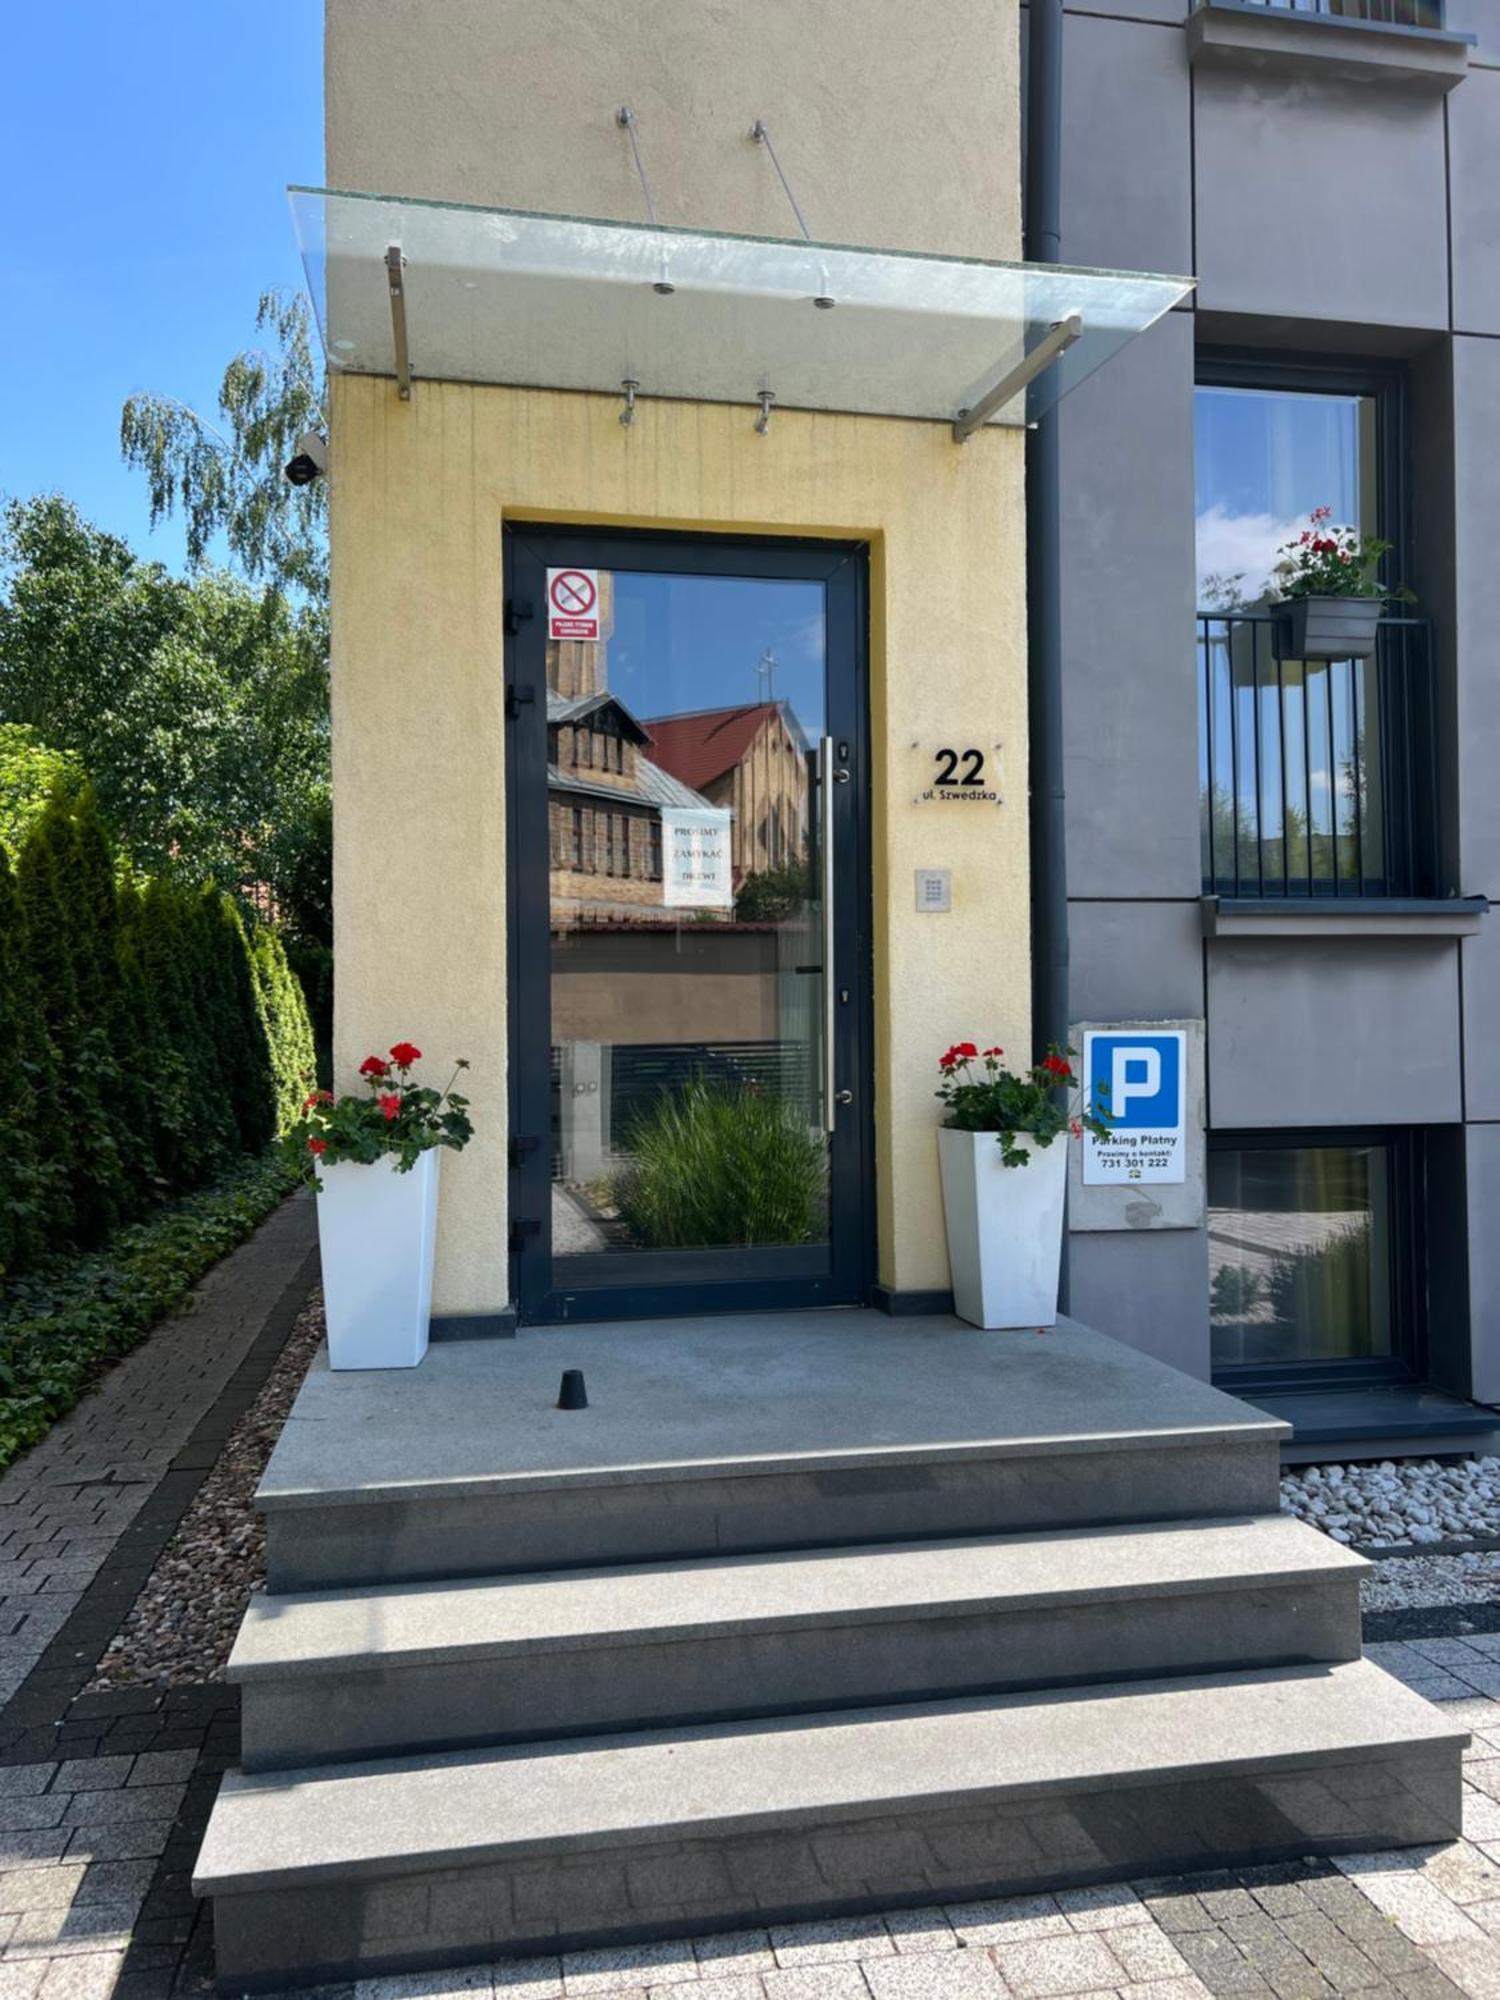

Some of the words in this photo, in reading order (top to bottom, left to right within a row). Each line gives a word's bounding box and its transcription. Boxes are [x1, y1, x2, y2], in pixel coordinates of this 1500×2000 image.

[934, 749, 985, 786] 22
[922, 790, 936, 801] ul.
[939, 790, 997, 801] Szwedzka
[1111, 1046, 1162, 1119] P
[1102, 1159, 1122, 1168] 731
[1124, 1159, 1145, 1168] 301
[1148, 1158, 1169, 1168] 222
